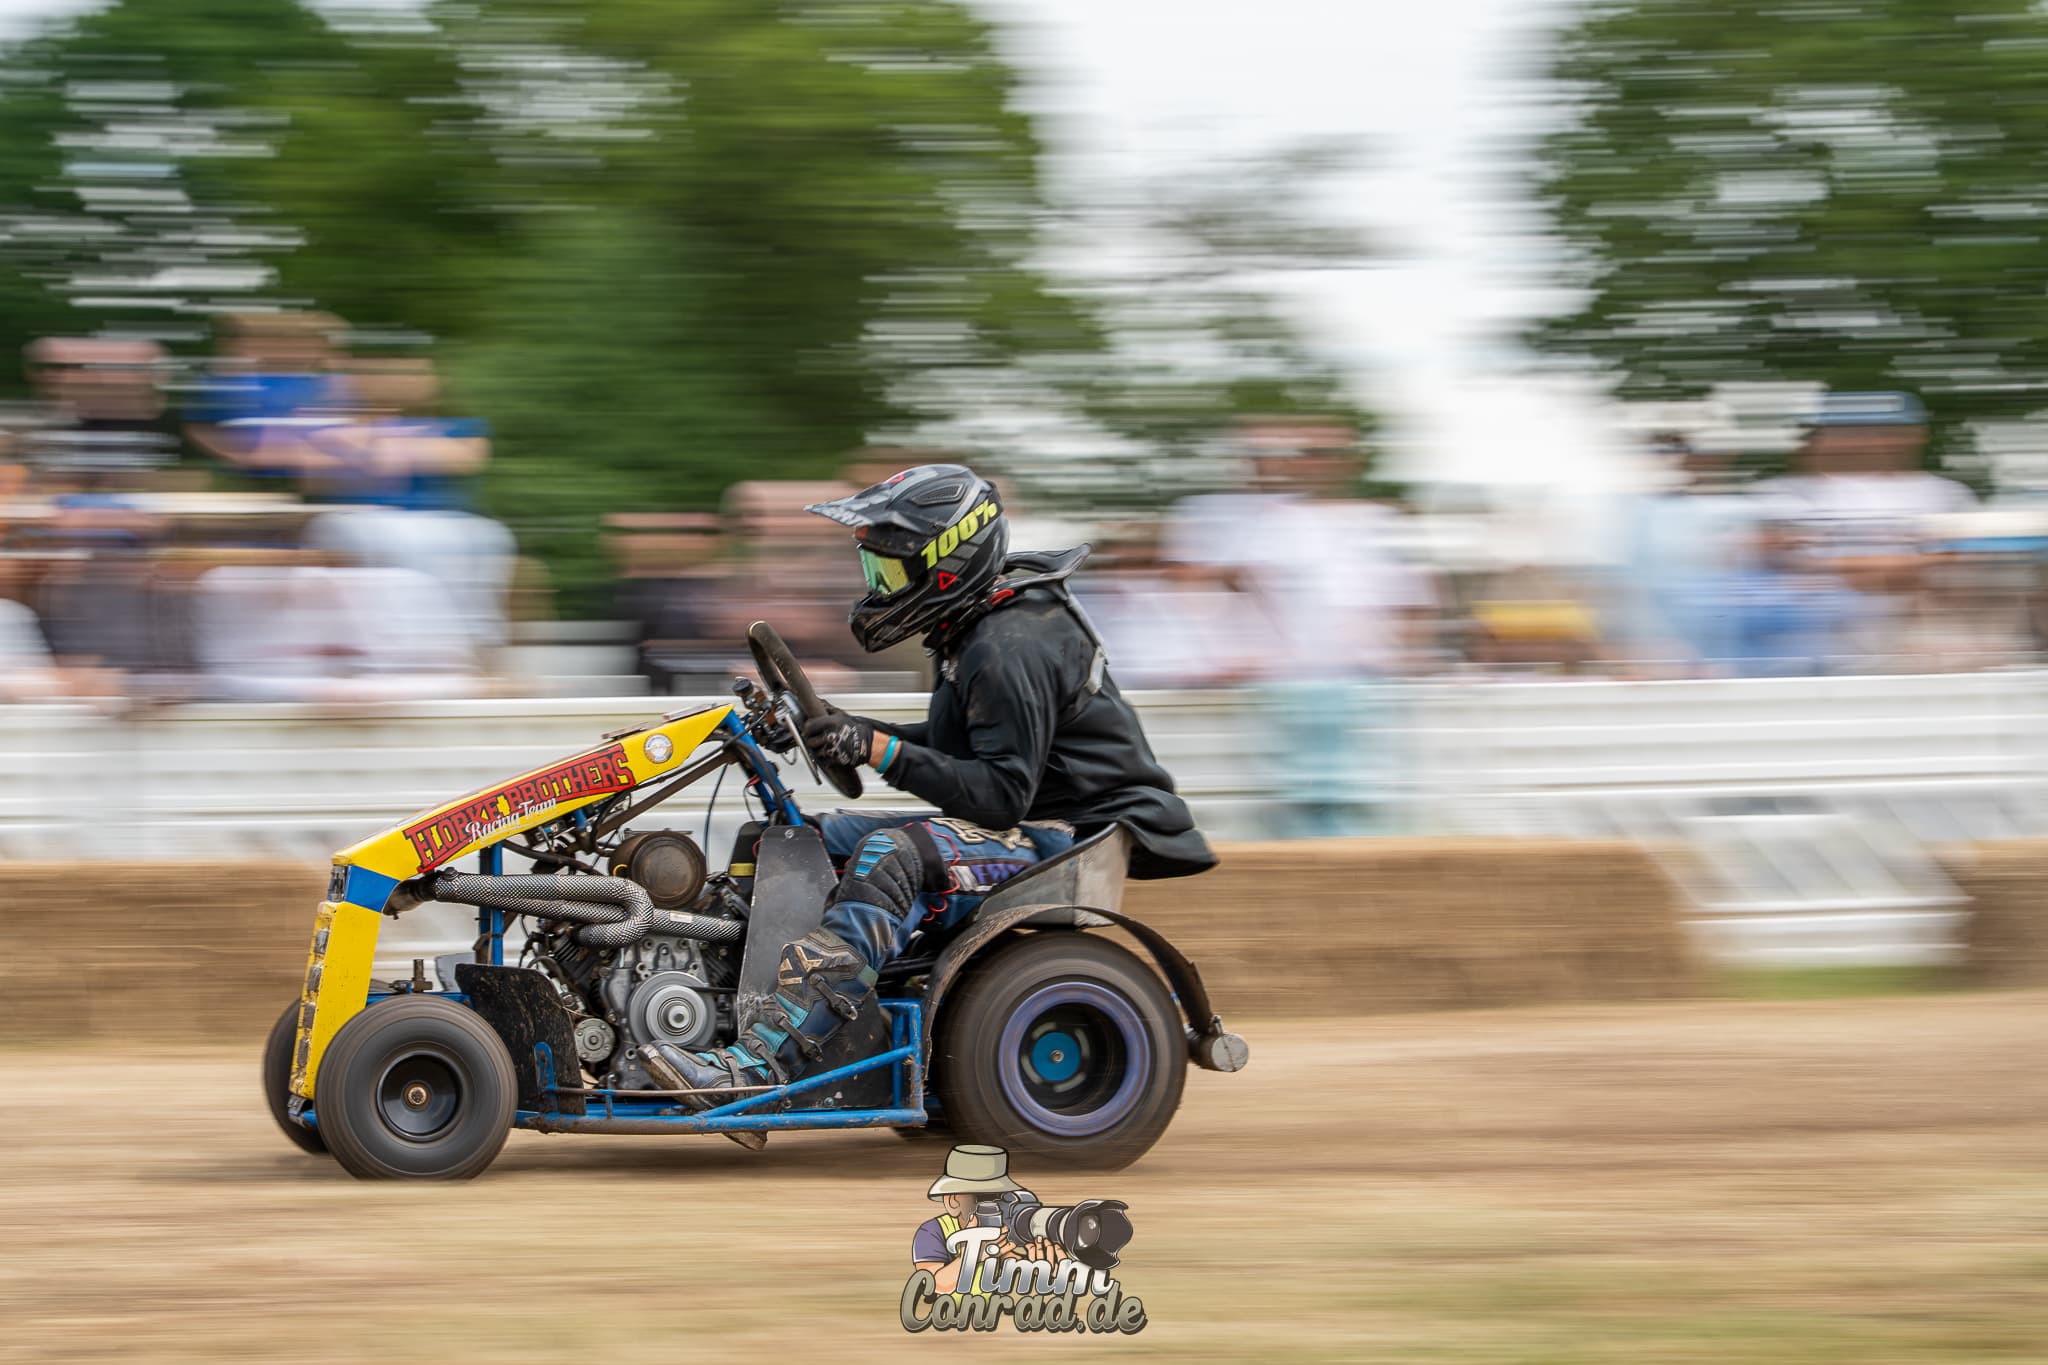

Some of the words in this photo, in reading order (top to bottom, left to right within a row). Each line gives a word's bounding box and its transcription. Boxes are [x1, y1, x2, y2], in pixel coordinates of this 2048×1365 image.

[921, 499, 998, 569] 100%
[507, 745, 636, 814] BROTHERS
[465, 811, 520, 843] Racing
[518, 797, 557, 820] Team
